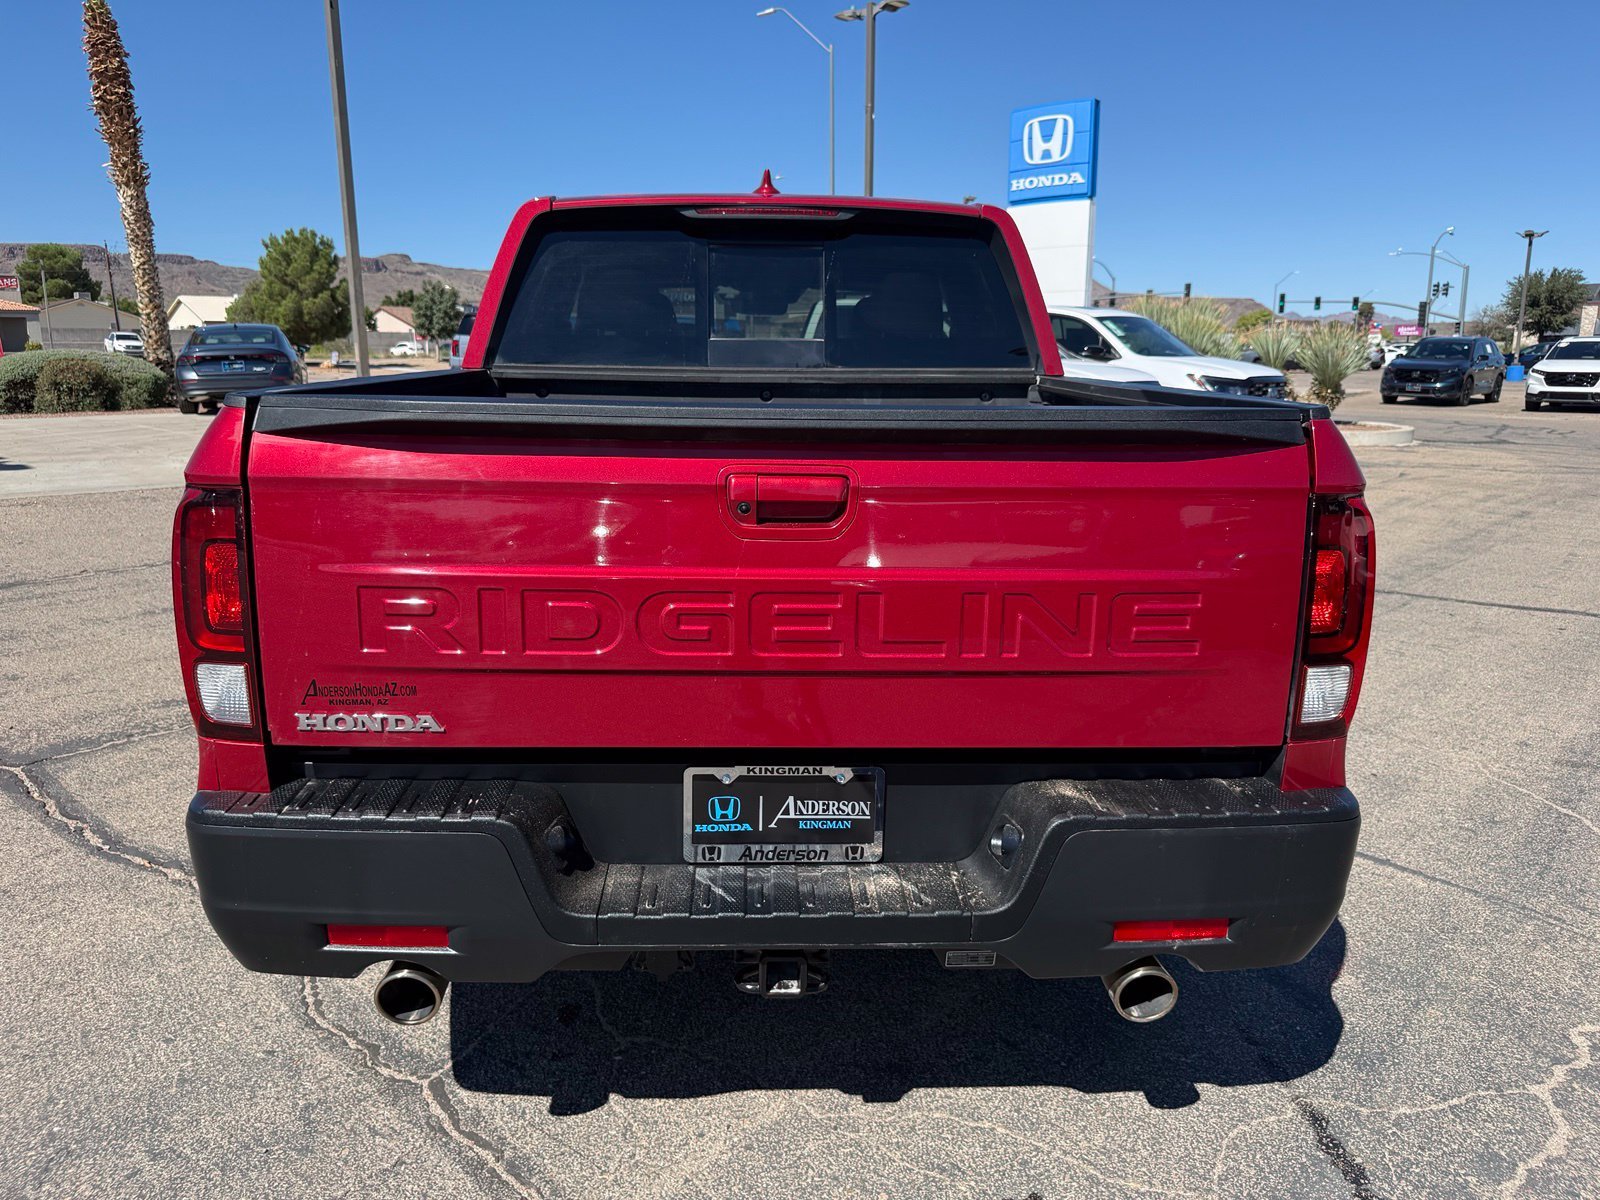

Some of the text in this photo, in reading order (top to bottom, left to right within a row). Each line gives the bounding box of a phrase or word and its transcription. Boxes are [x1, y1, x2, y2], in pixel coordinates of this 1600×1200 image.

[1010, 172, 1085, 191] HONDA
[357, 585, 1203, 658] RIDGELINE
[294, 712, 446, 733] HONDA
[746, 766, 823, 775] KINGMAN
[768, 795, 871, 828] ANDERSON
[695, 823, 753, 832] HONDA
[799, 820, 851, 829] KINGMAN
[738, 846, 829, 861] Anderson
